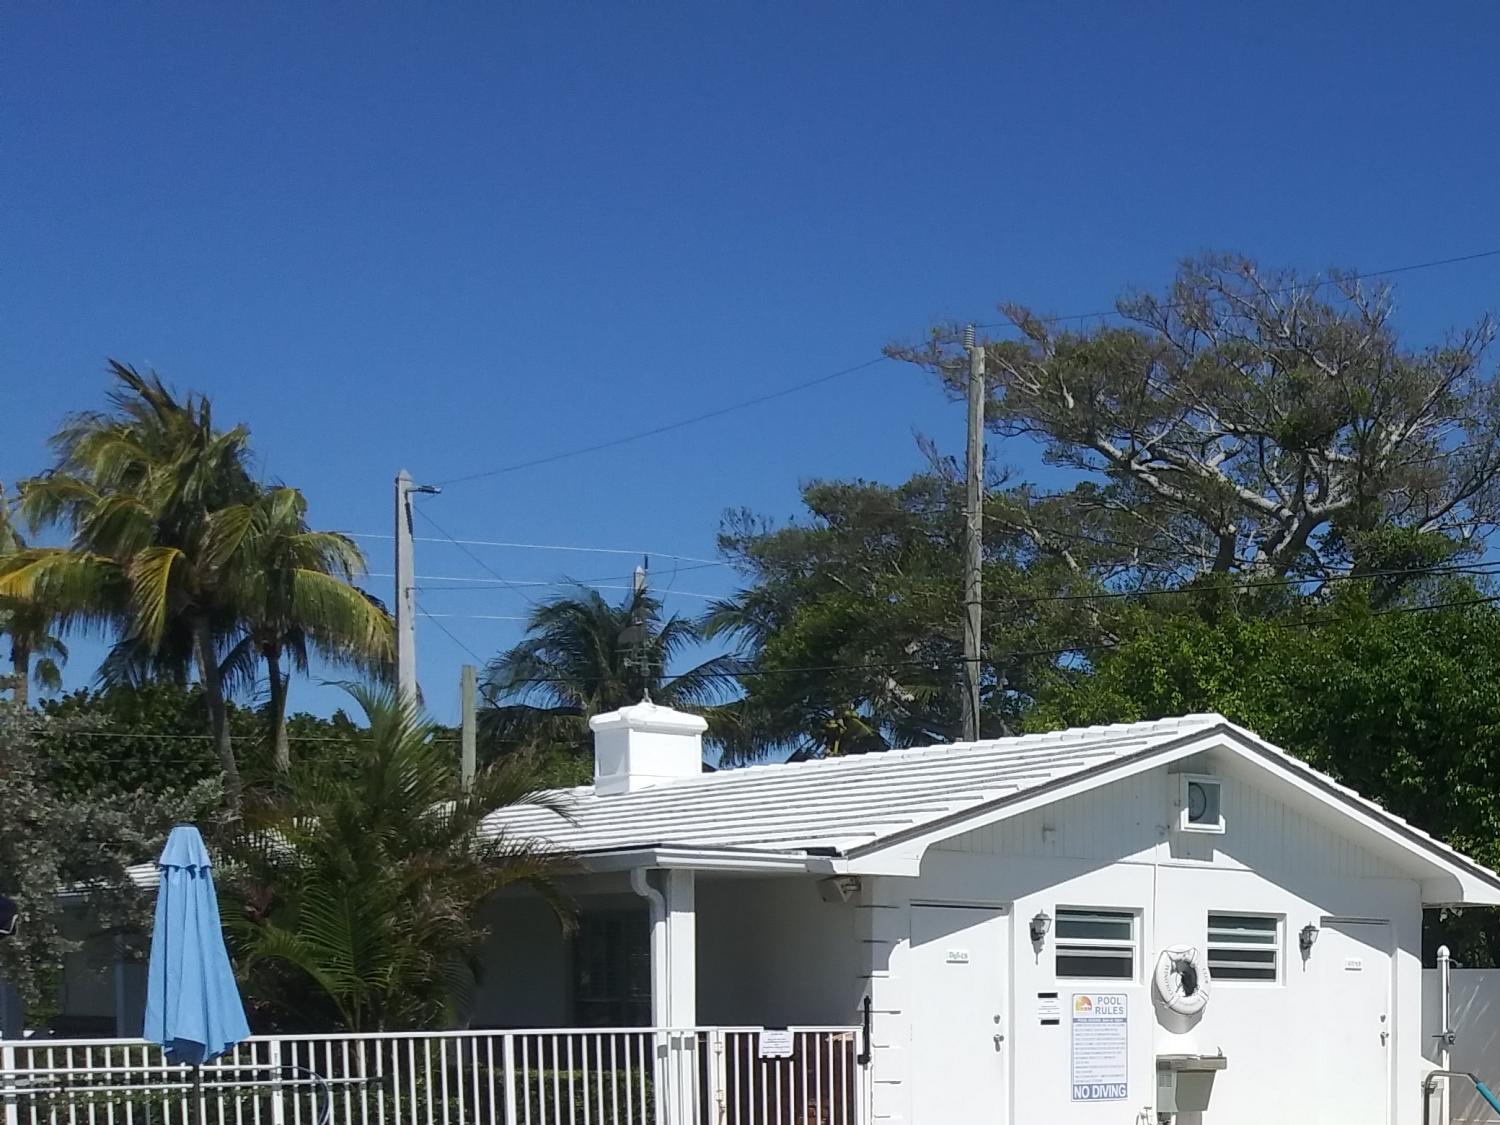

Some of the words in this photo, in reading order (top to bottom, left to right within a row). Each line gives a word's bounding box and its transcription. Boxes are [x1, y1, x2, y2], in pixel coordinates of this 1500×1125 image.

[1097, 996, 1121, 1005] POOL
[1095, 1006, 1124, 1015] RULES
[1074, 1085, 1090, 1099] NO
[1092, 1083, 1127, 1099] DIVING
